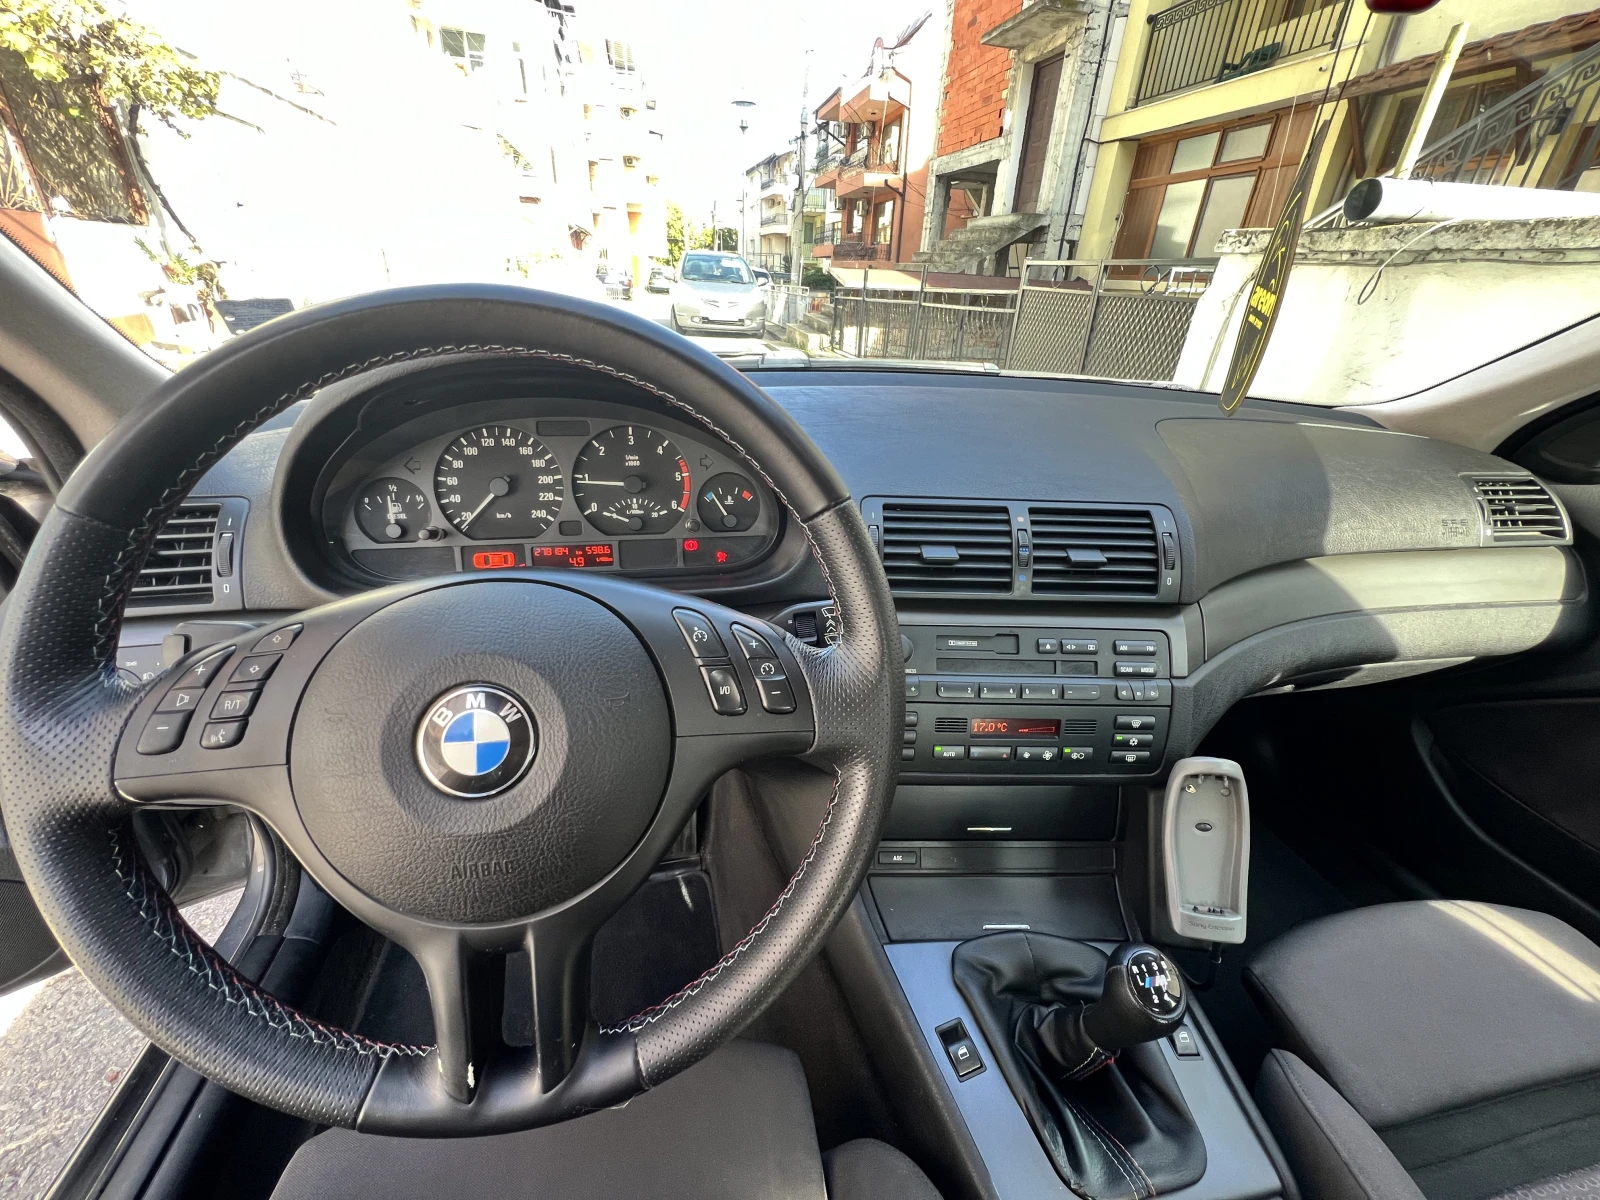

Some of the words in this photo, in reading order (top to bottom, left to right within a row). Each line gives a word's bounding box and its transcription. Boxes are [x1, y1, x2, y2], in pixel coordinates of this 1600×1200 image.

[481, 438, 495, 447] 120
[502, 438, 516, 447] 140
[628, 436, 634, 445] 3
[463, 447, 478, 456] 100
[519, 447, 533, 455] 160
[599, 446, 605, 456] 2
[657, 445, 664, 455] 4
[452, 460, 464, 469] 80
[531, 459, 546, 468] 180
[538, 475, 554, 484] 200
[584, 473, 589, 482] 1
[675, 472, 681, 481] 5
[446, 477, 458, 486] 60
[449, 494, 461, 503] 40
[539, 492, 554, 501] 220
[591, 502, 598, 512] 0
[671, 501, 678, 510] 6
[461, 512, 472, 520] 20
[531, 510, 547, 518] 240
[224, 699, 241, 710] R/T
[432, 692, 522, 728] BMW
[450, 860, 513, 880] AIRBAG
[1188, 920, 1206, 929] Sony
[1151, 961, 1159, 970] 3
